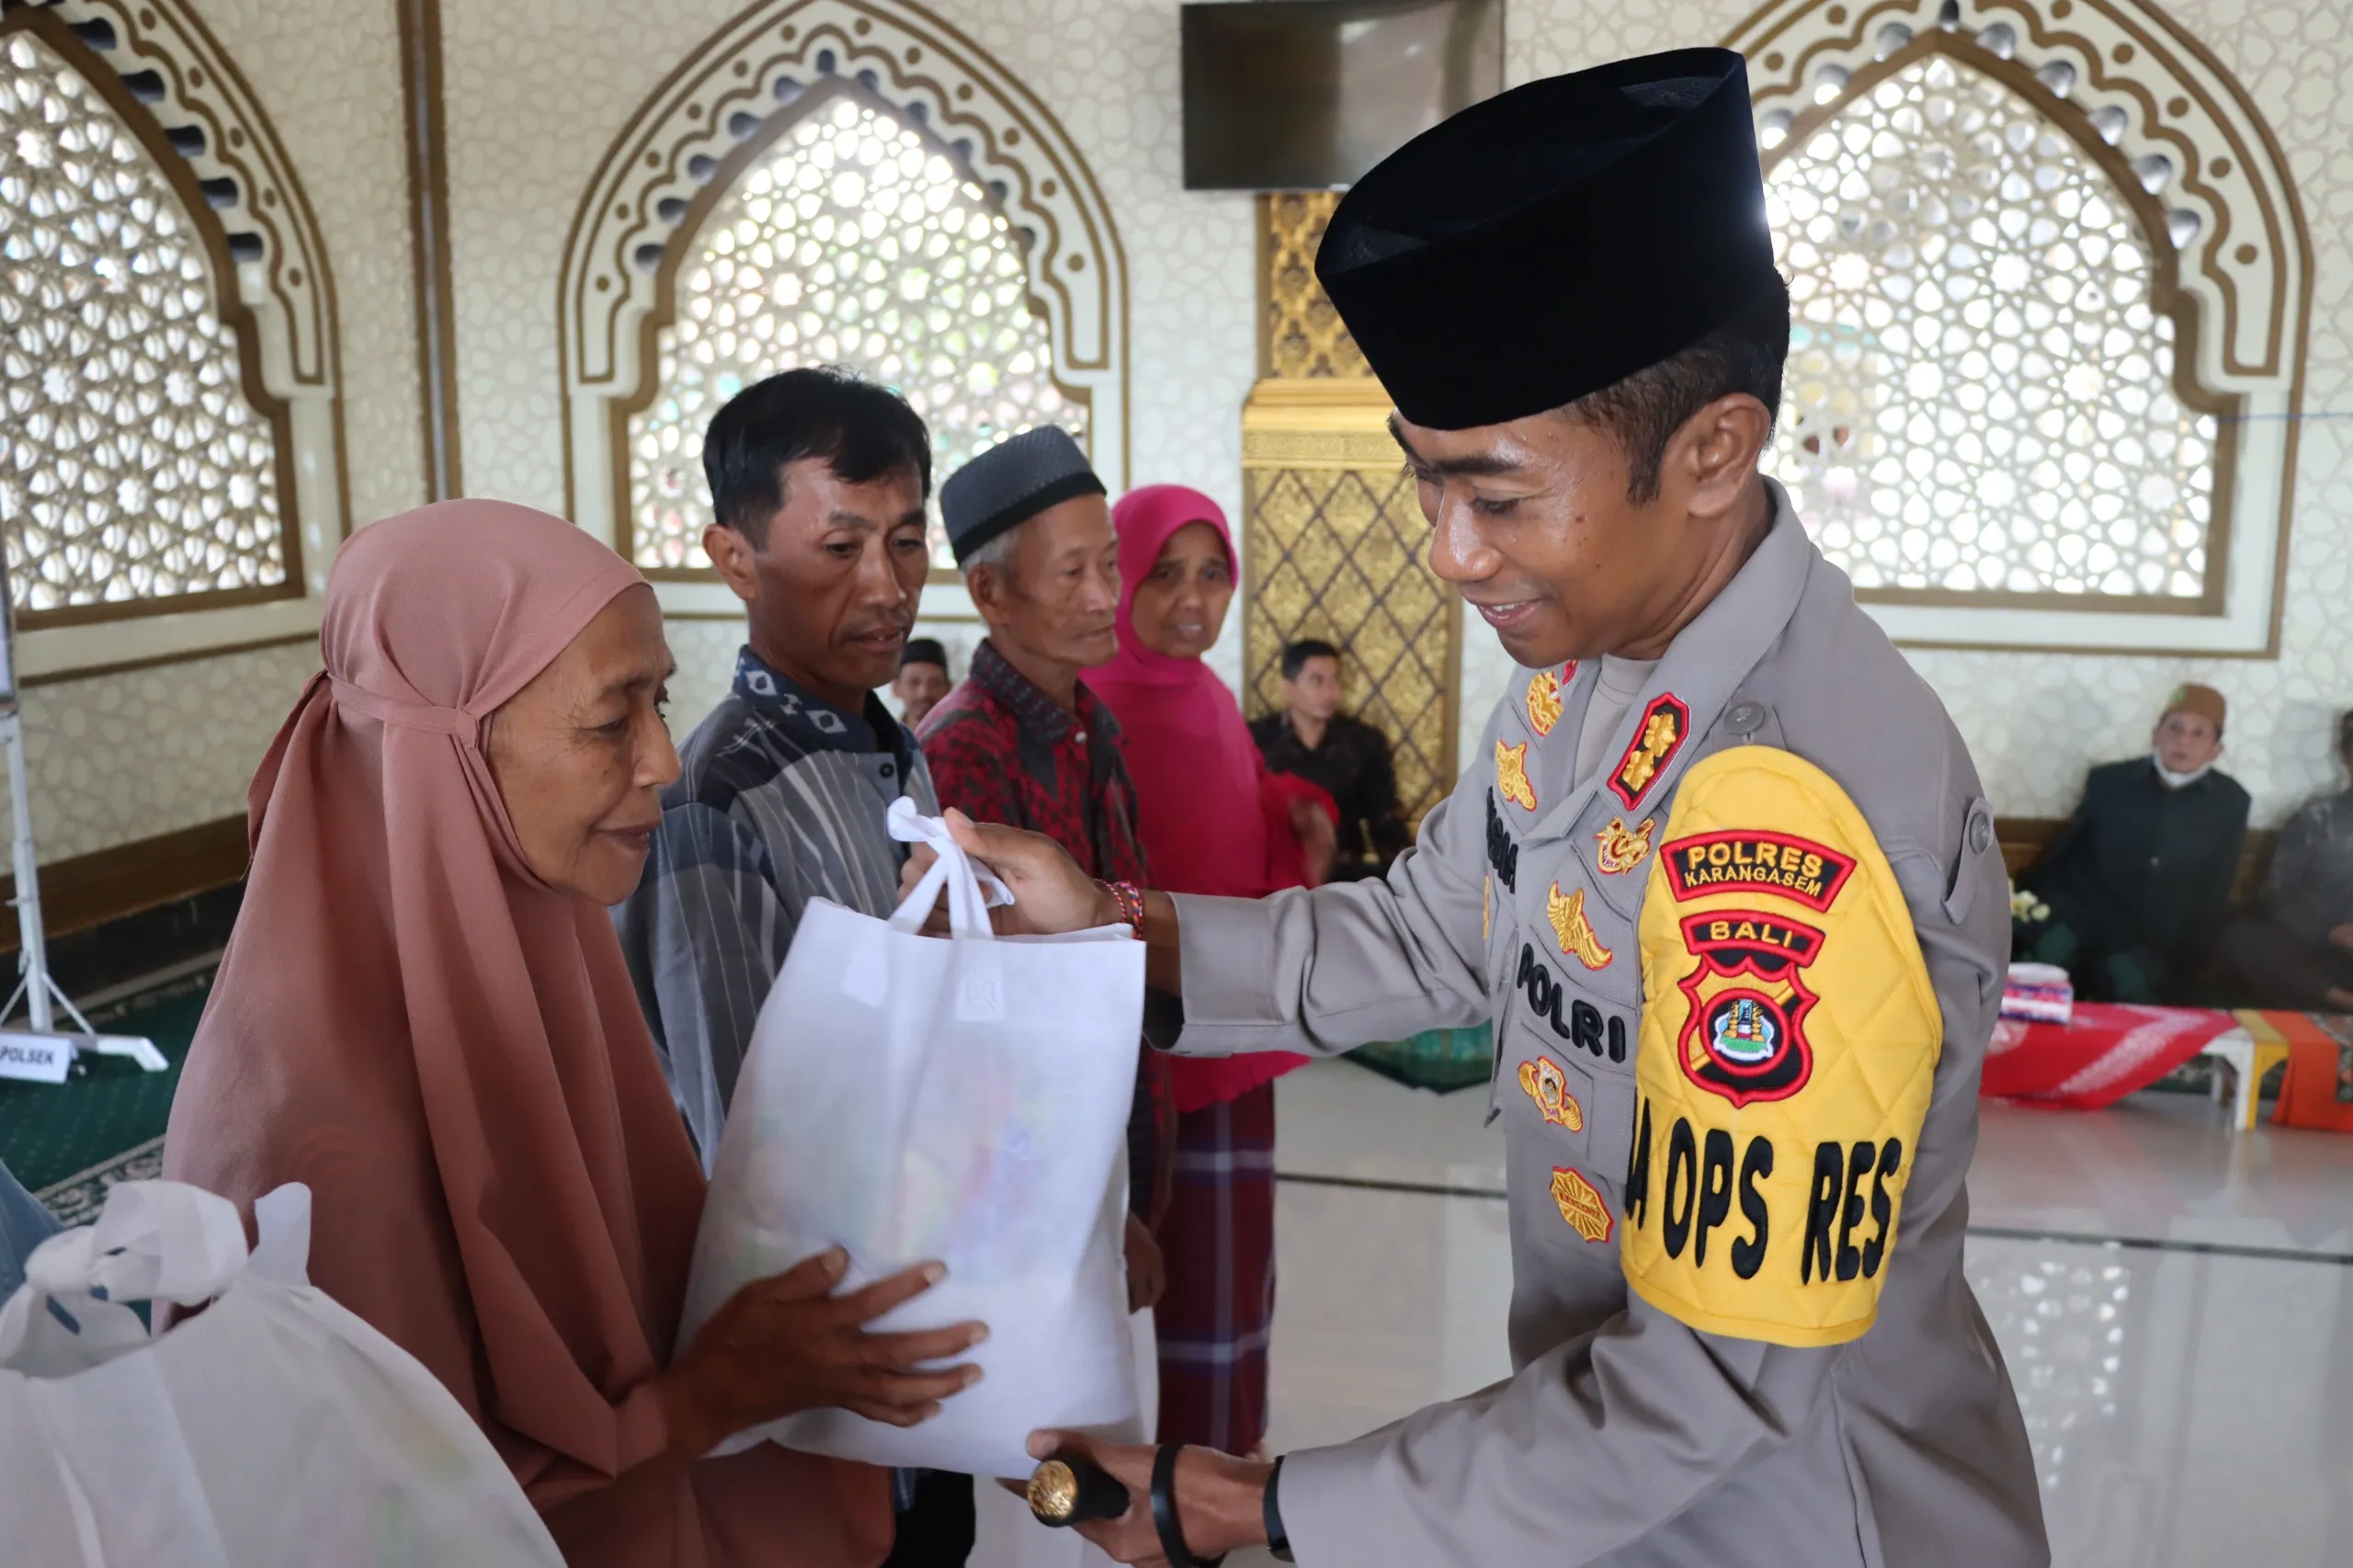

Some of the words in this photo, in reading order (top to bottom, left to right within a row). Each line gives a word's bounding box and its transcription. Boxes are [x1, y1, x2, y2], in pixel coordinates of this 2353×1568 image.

[1688, 841, 1824, 879] POLRES
[1685, 865, 1823, 897] KARANGASEM
[1710, 921, 1792, 948] BALI
[1517, 942, 1626, 1064] POLRI
[1625, 1086, 1651, 1231] A
[1664, 1117, 1774, 1280] OPS
[1801, 1136, 1902, 1286] RES
